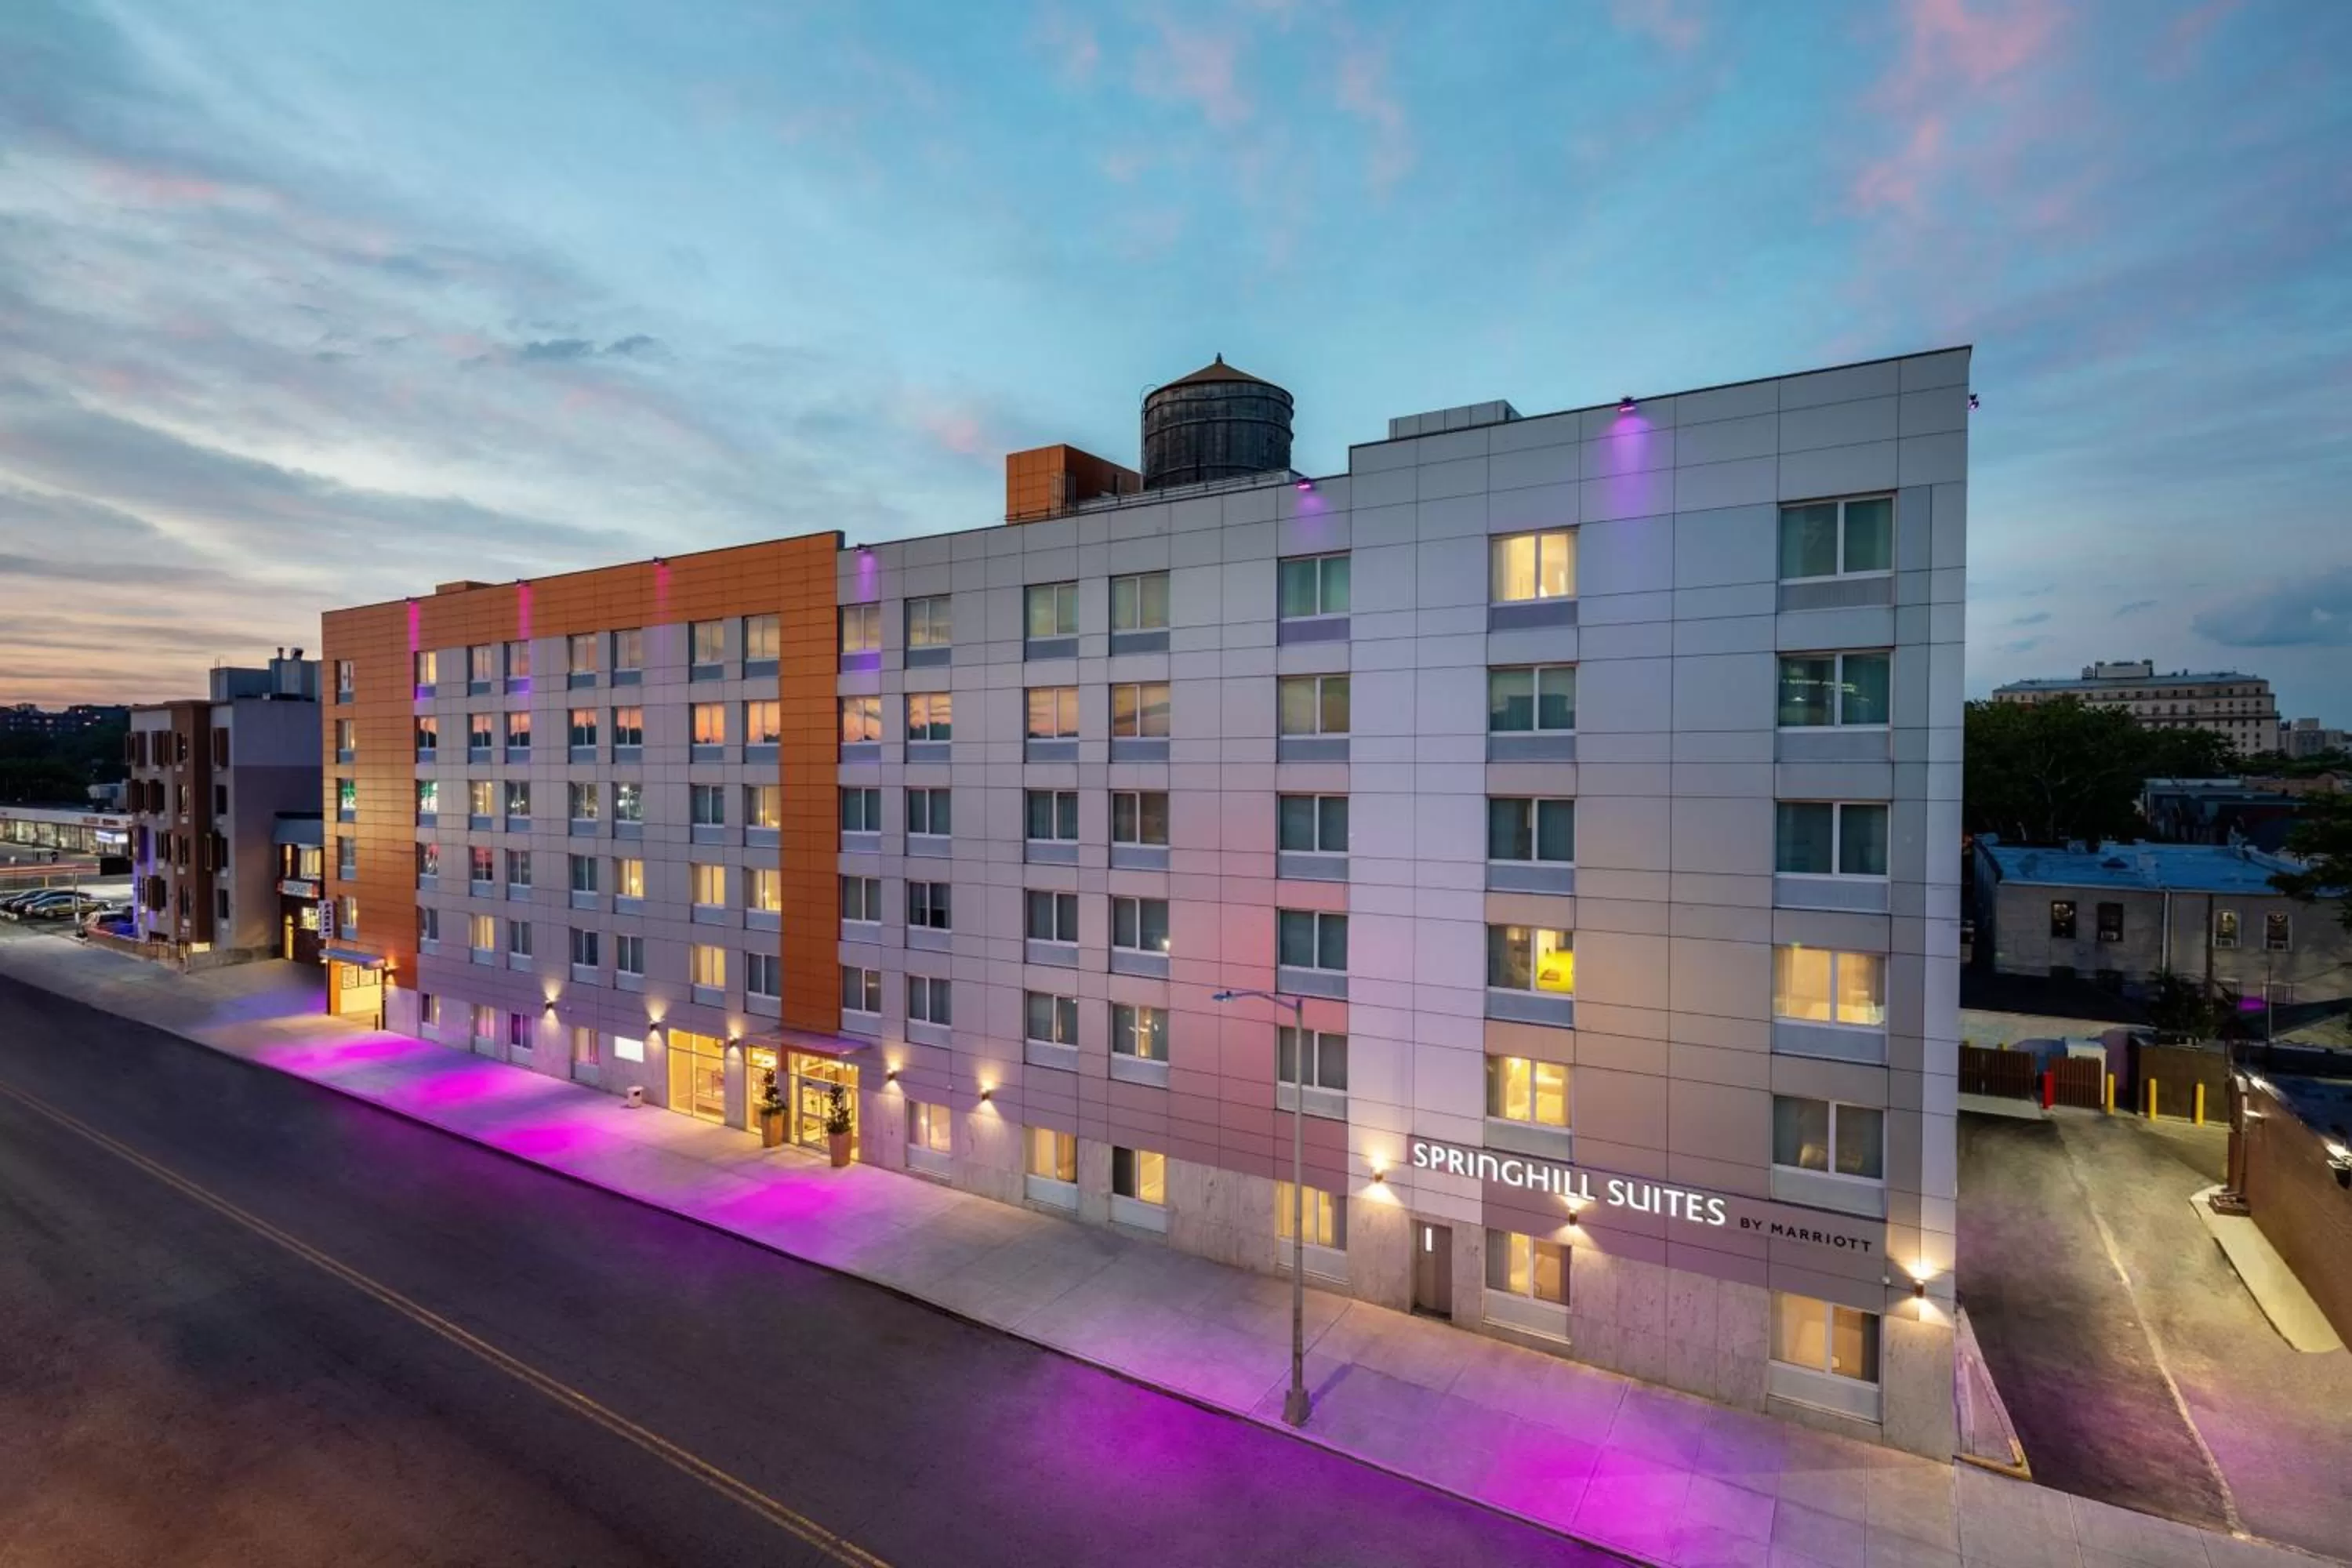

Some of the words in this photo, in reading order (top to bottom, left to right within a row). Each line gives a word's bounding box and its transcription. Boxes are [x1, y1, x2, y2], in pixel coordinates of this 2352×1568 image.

[1413, 1142, 1596, 1201] SPRINGHILL
[1607, 1178, 1726, 1225] SUITES
[1740, 1217, 1763, 1230] BY
[1770, 1222, 1872, 1252] MARRIOTT
